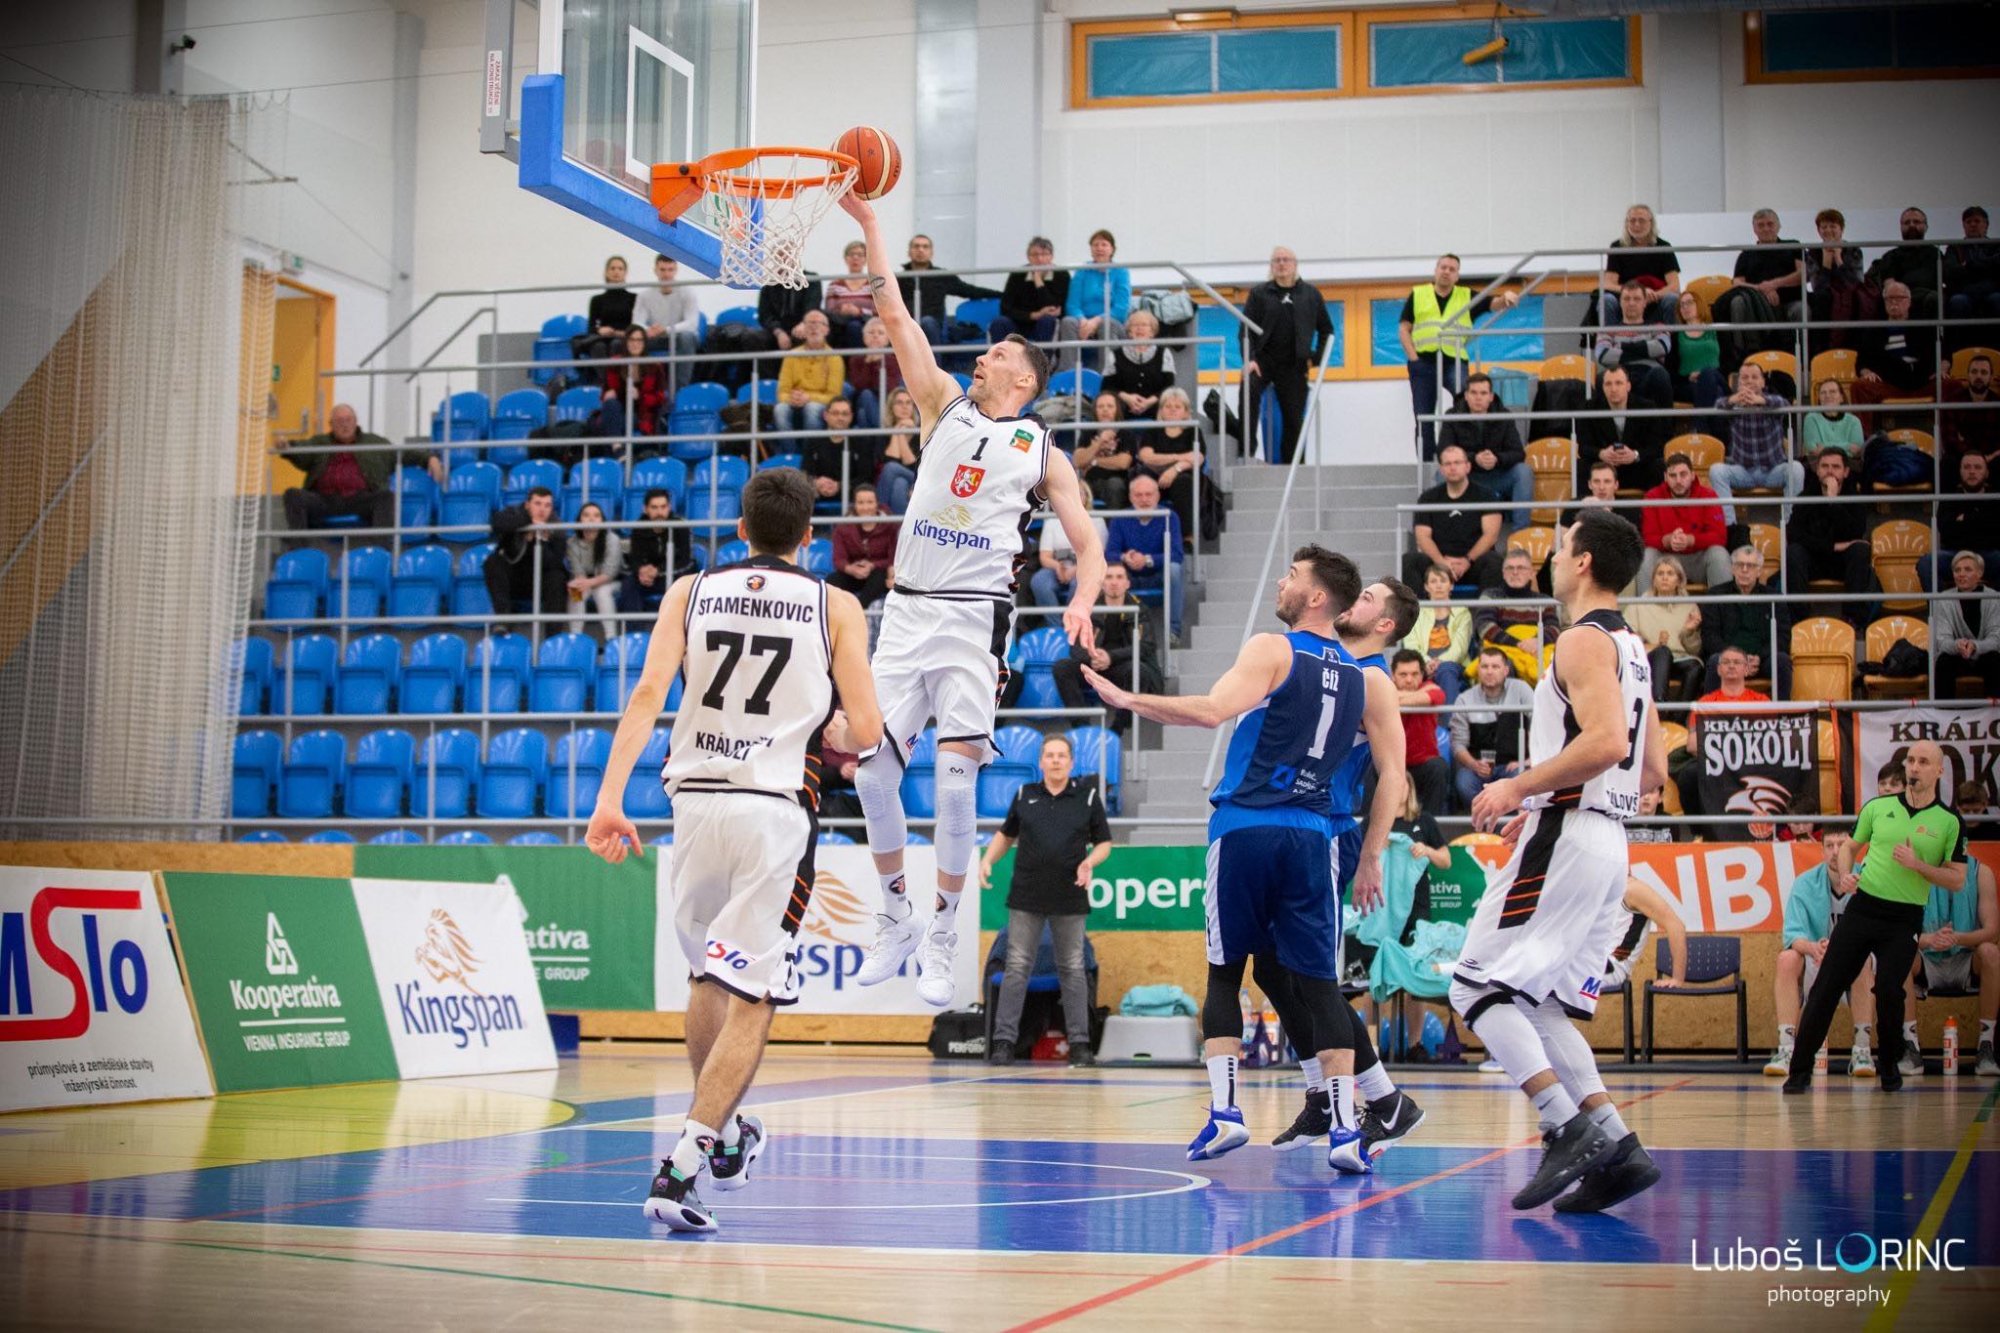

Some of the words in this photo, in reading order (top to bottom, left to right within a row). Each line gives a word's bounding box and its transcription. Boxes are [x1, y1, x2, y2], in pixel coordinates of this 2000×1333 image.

[971, 437, 989, 461] 1
[913, 519, 991, 550] Kingspan
[698, 597, 813, 624] STAMENKOVIC
[701, 630, 793, 716] 77
[1307, 694, 1336, 760] 1
[1704, 713, 1811, 733] KRÁLOVŠTÍ
[1704, 728, 1812, 777] SOKOLI
[1087, 877, 1207, 920] oper
[1429, 881, 1462, 895] ativa
[524, 922, 591, 950] ativa
[543, 967, 591, 981] GROUP
[229, 975, 342, 1017] Kooperativa
[394, 980, 523, 1049] Kingspan
[243, 1035, 278, 1052] VIENNA
[276, 1032, 325, 1050] INSURANCE
[323, 1031, 351, 1047] GROUP
[27, 1061, 79, 1079] průmyslové
[79, 1062, 86, 1072] a
[129, 1058, 155, 1073] stavby
